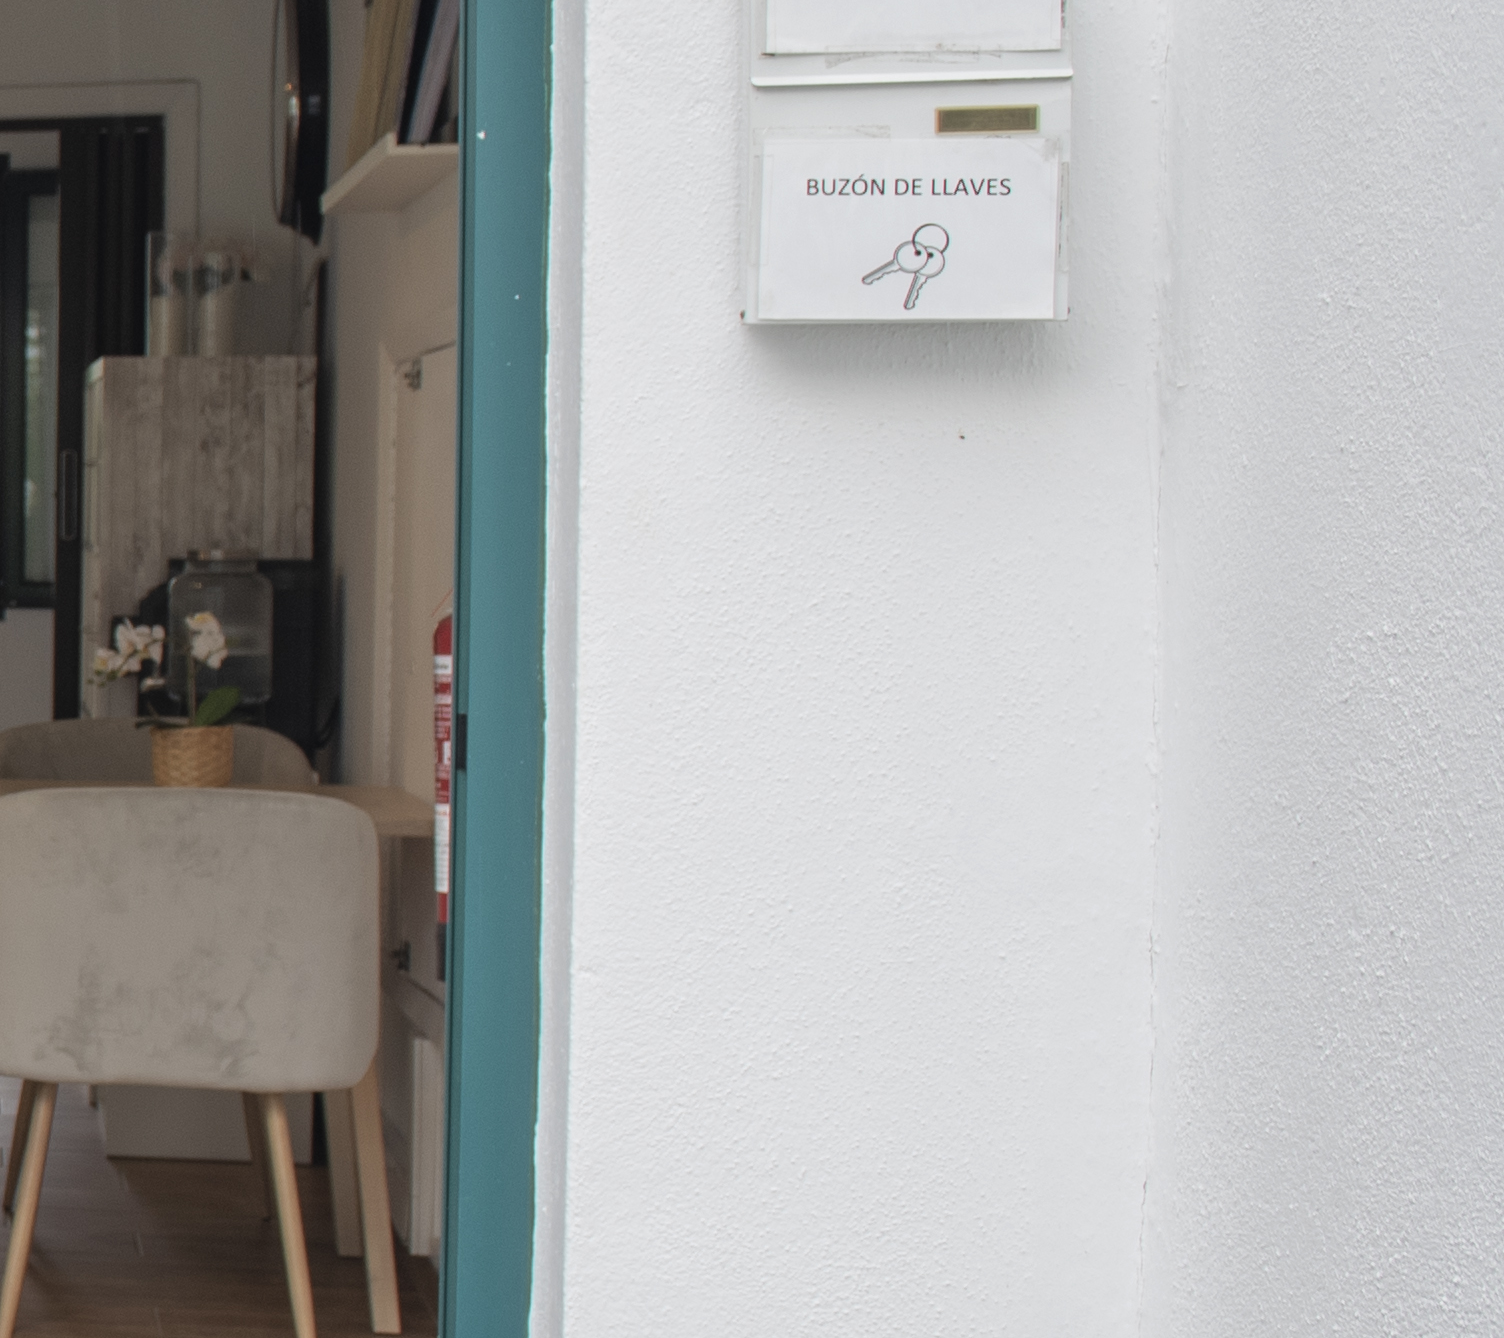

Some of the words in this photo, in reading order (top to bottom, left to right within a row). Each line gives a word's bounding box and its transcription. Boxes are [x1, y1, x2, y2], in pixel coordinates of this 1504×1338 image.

[806, 173, 885, 197] BUZÓN
[894, 177, 923, 196] DE
[931, 177, 1012, 196] LLAVES
